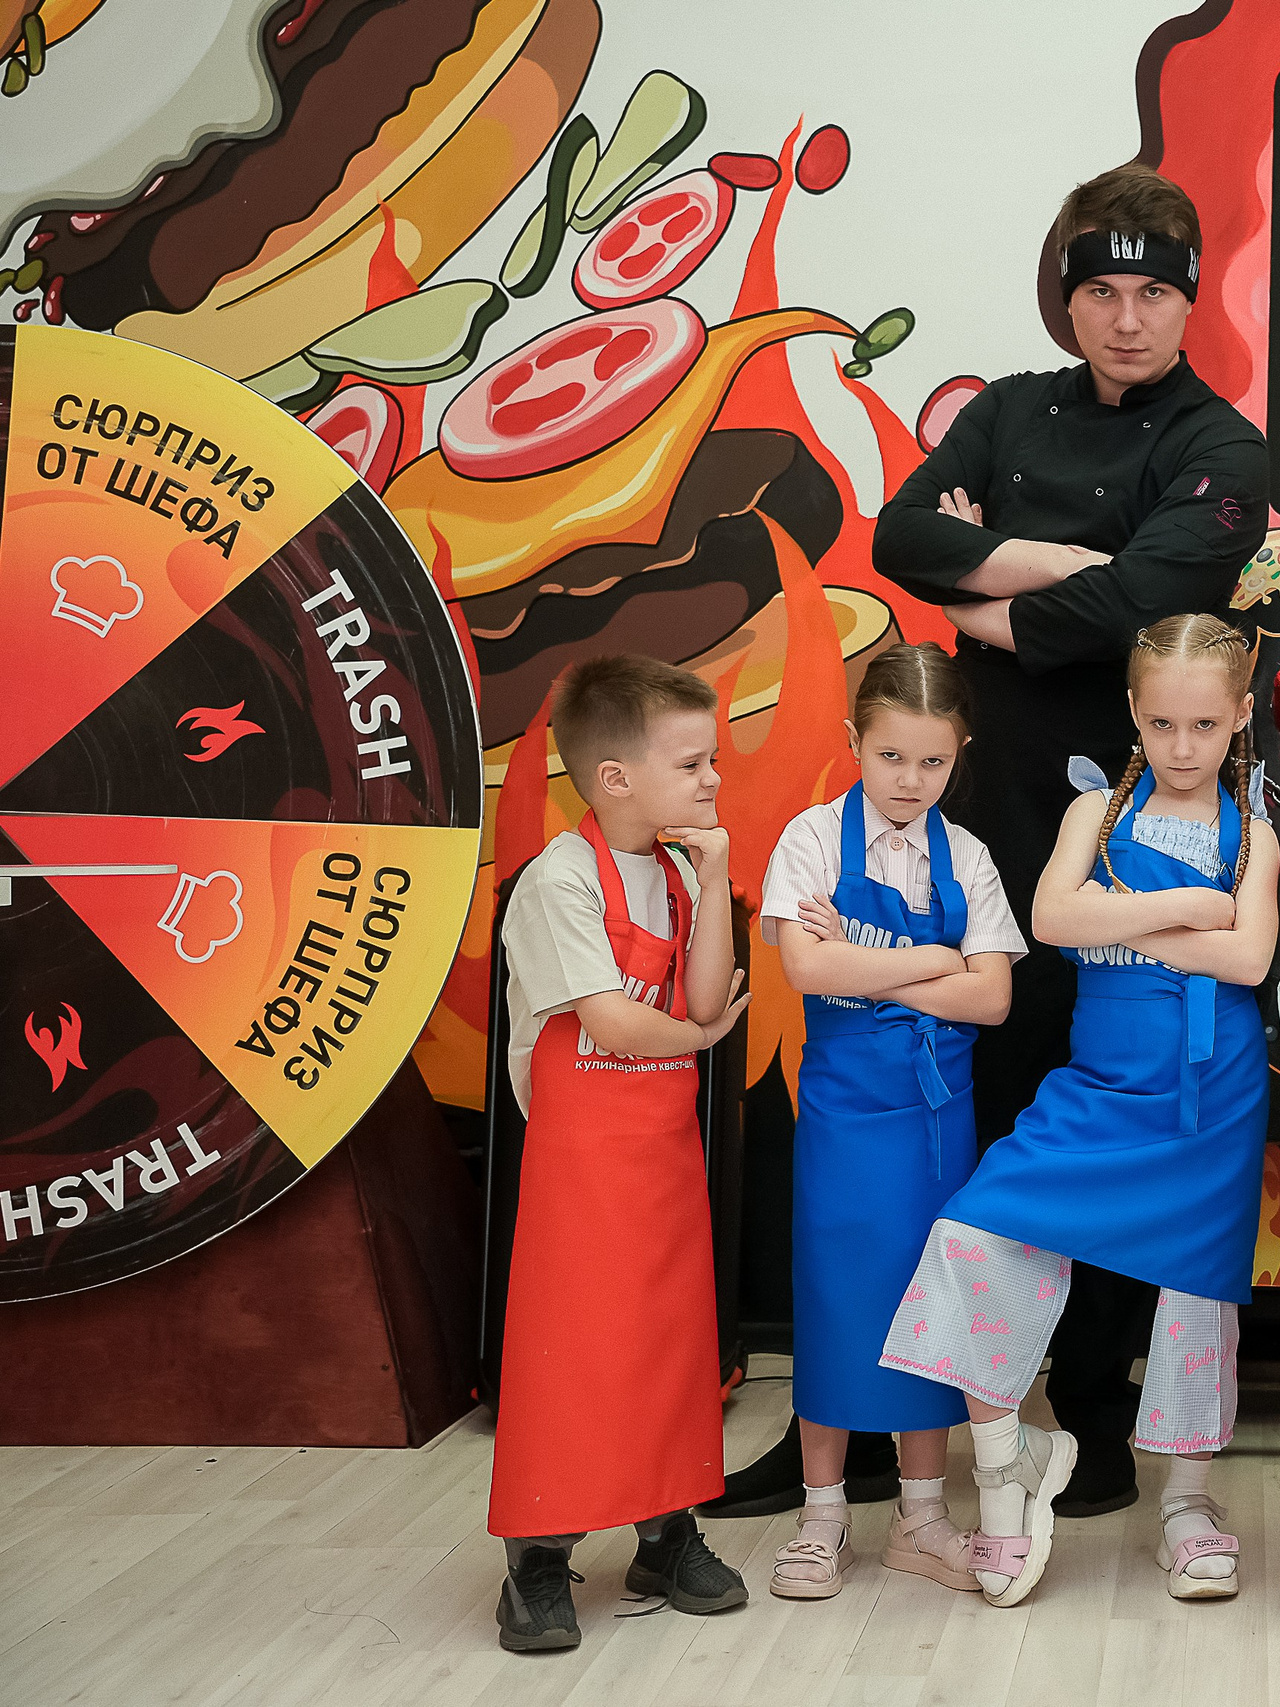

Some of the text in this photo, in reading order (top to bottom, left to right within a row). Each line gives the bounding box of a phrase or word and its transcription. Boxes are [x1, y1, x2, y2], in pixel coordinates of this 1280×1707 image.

[37, 442, 243, 559] ОТ ШЕФА
[52, 394, 275, 512] СЮРПРИЗ
[301, 568, 411, 780] TRASH
[234, 852, 362, 1058] ОТ ШЕФА
[283, 866, 411, 1091] СЮРПРИЗ
[575, 1060, 657, 1074] кулинарные
[0, 1122, 221, 1241] TRASH
[946, 1239, 989, 1263] Barbie
[970, 1313, 1013, 1335] Barbie
